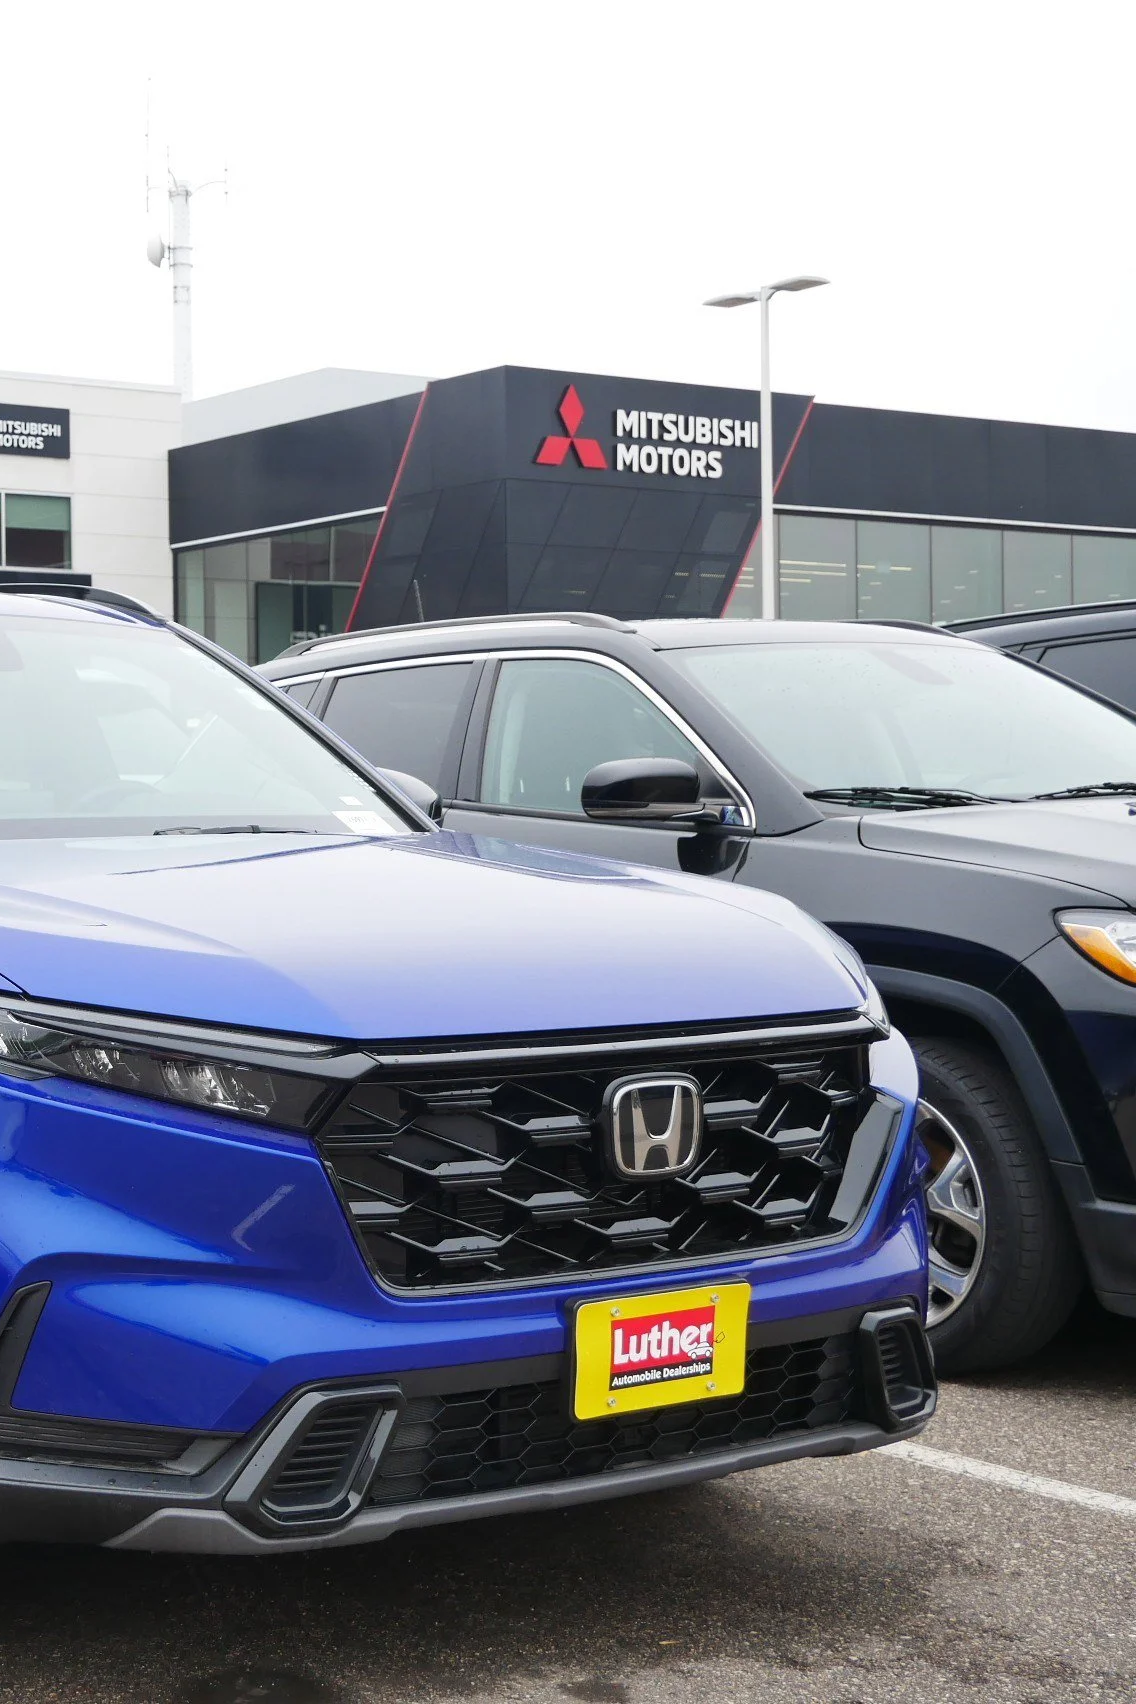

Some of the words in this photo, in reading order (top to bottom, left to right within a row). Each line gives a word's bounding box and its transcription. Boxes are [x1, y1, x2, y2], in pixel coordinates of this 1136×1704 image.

[617, 408, 759, 449] MITSUBISHI
[616, 443, 723, 479] MOTORS
[613, 1320, 713, 1365] Luther
[611, 1369, 662, 1387] Automobile
[663, 1361, 711, 1378] Dealerships
